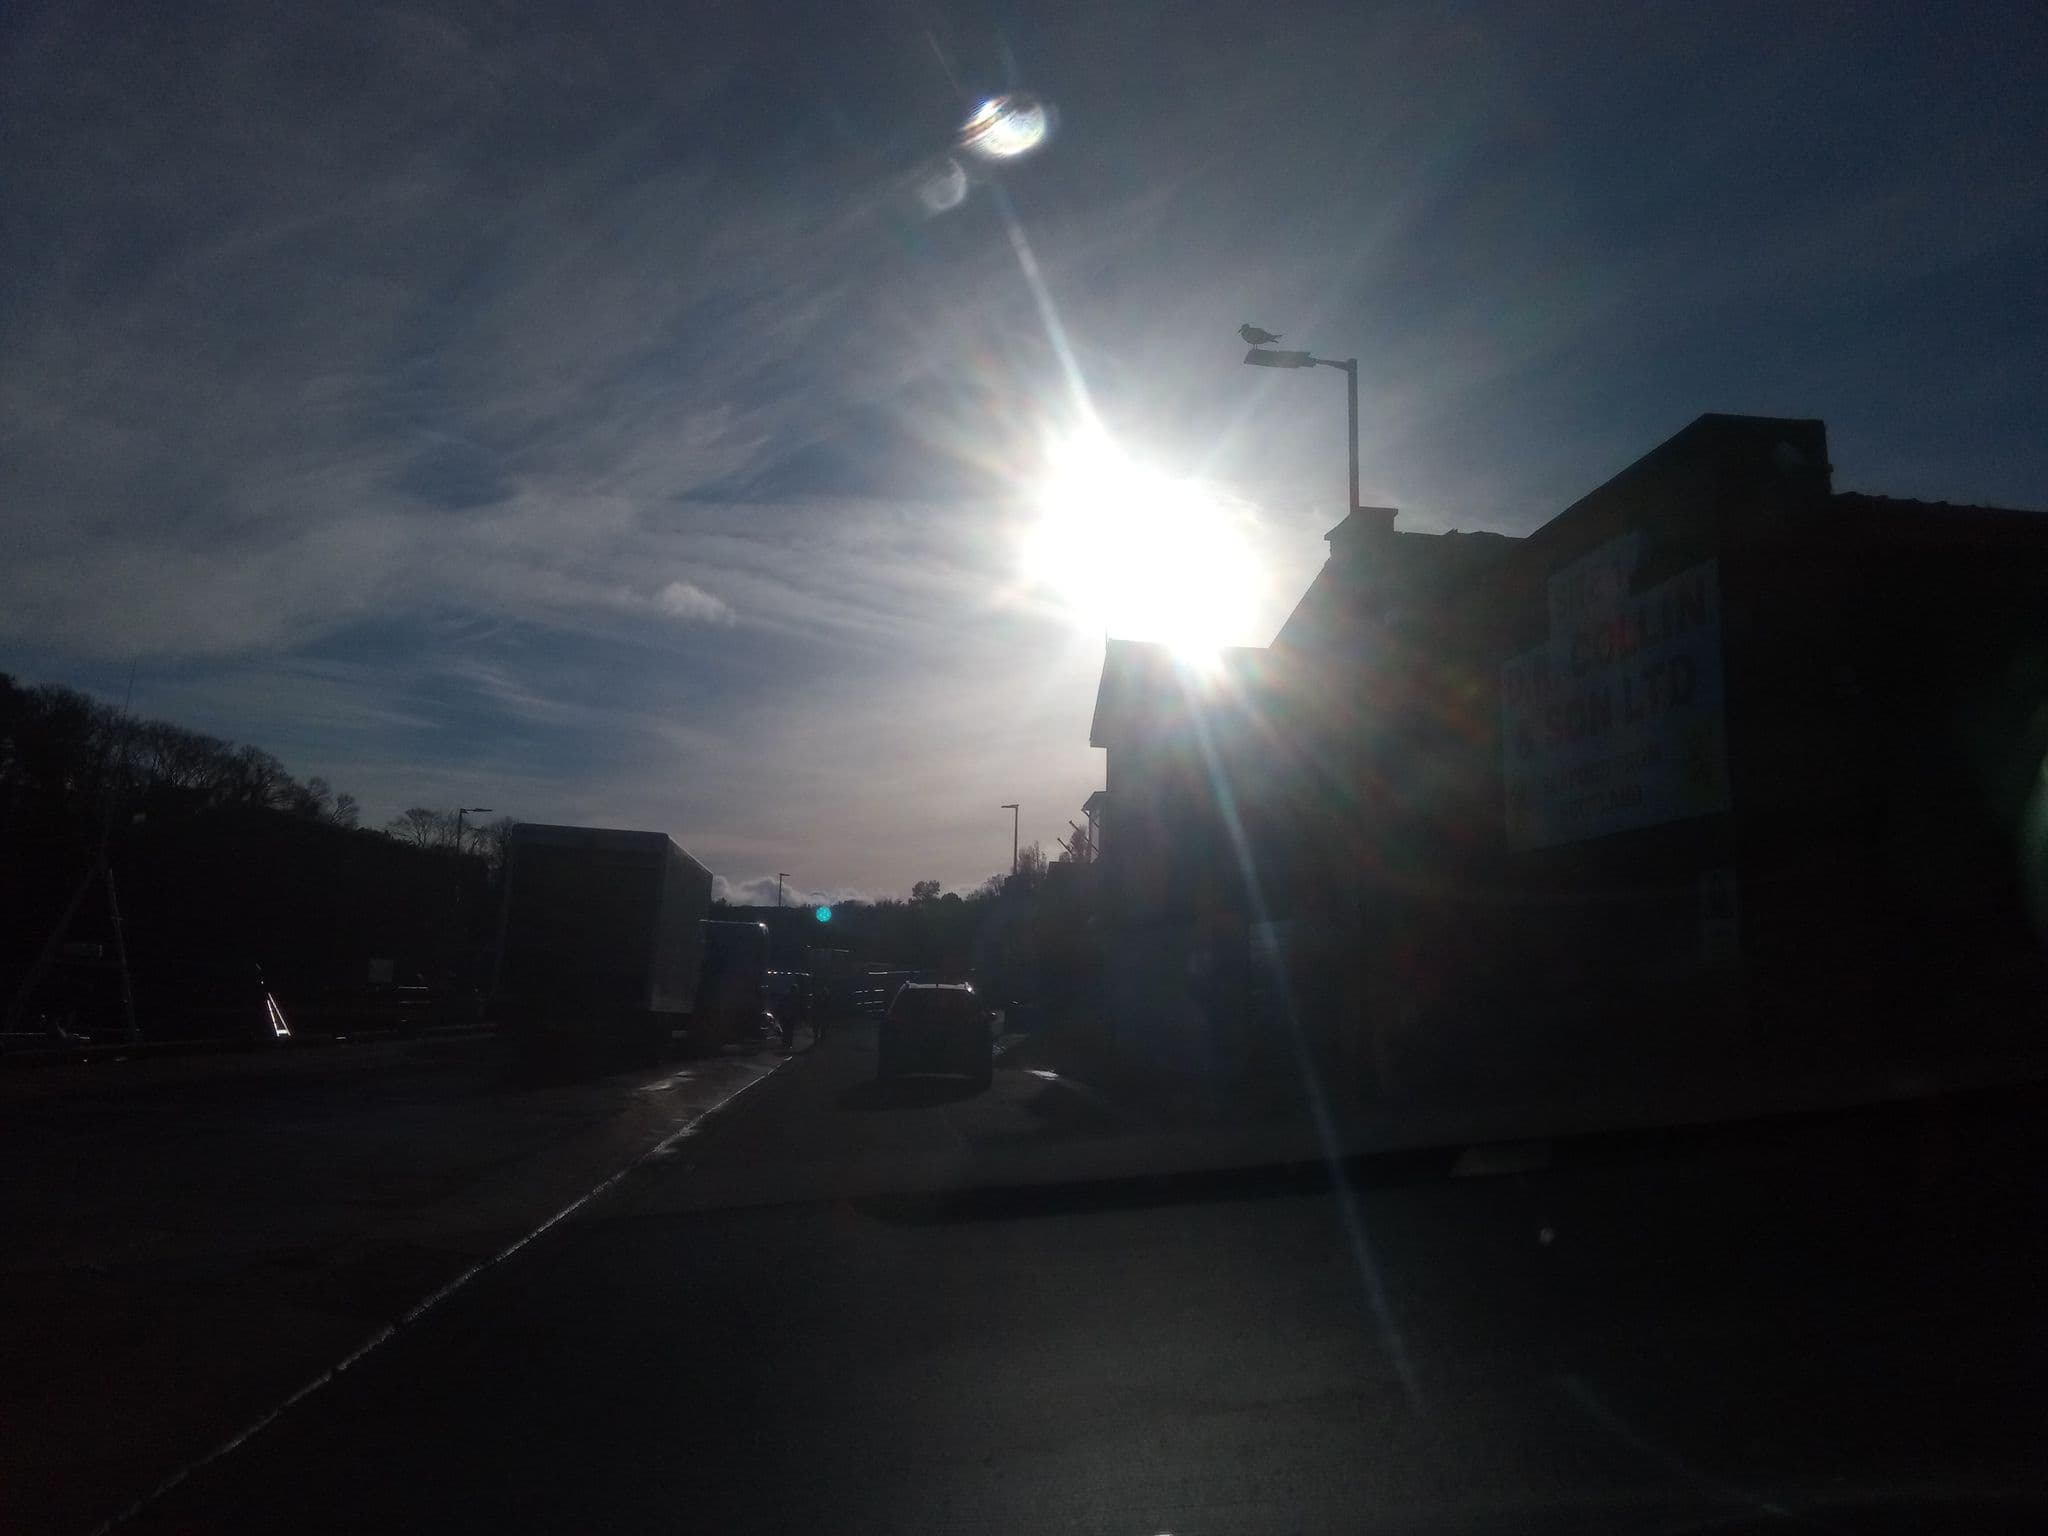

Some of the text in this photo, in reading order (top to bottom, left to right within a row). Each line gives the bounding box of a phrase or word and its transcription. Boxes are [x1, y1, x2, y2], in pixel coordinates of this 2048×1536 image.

[1570, 570, 1706, 681] COLLIN
[1544, 683, 1611, 751] SON
[1622, 648, 1697, 725] LTD
